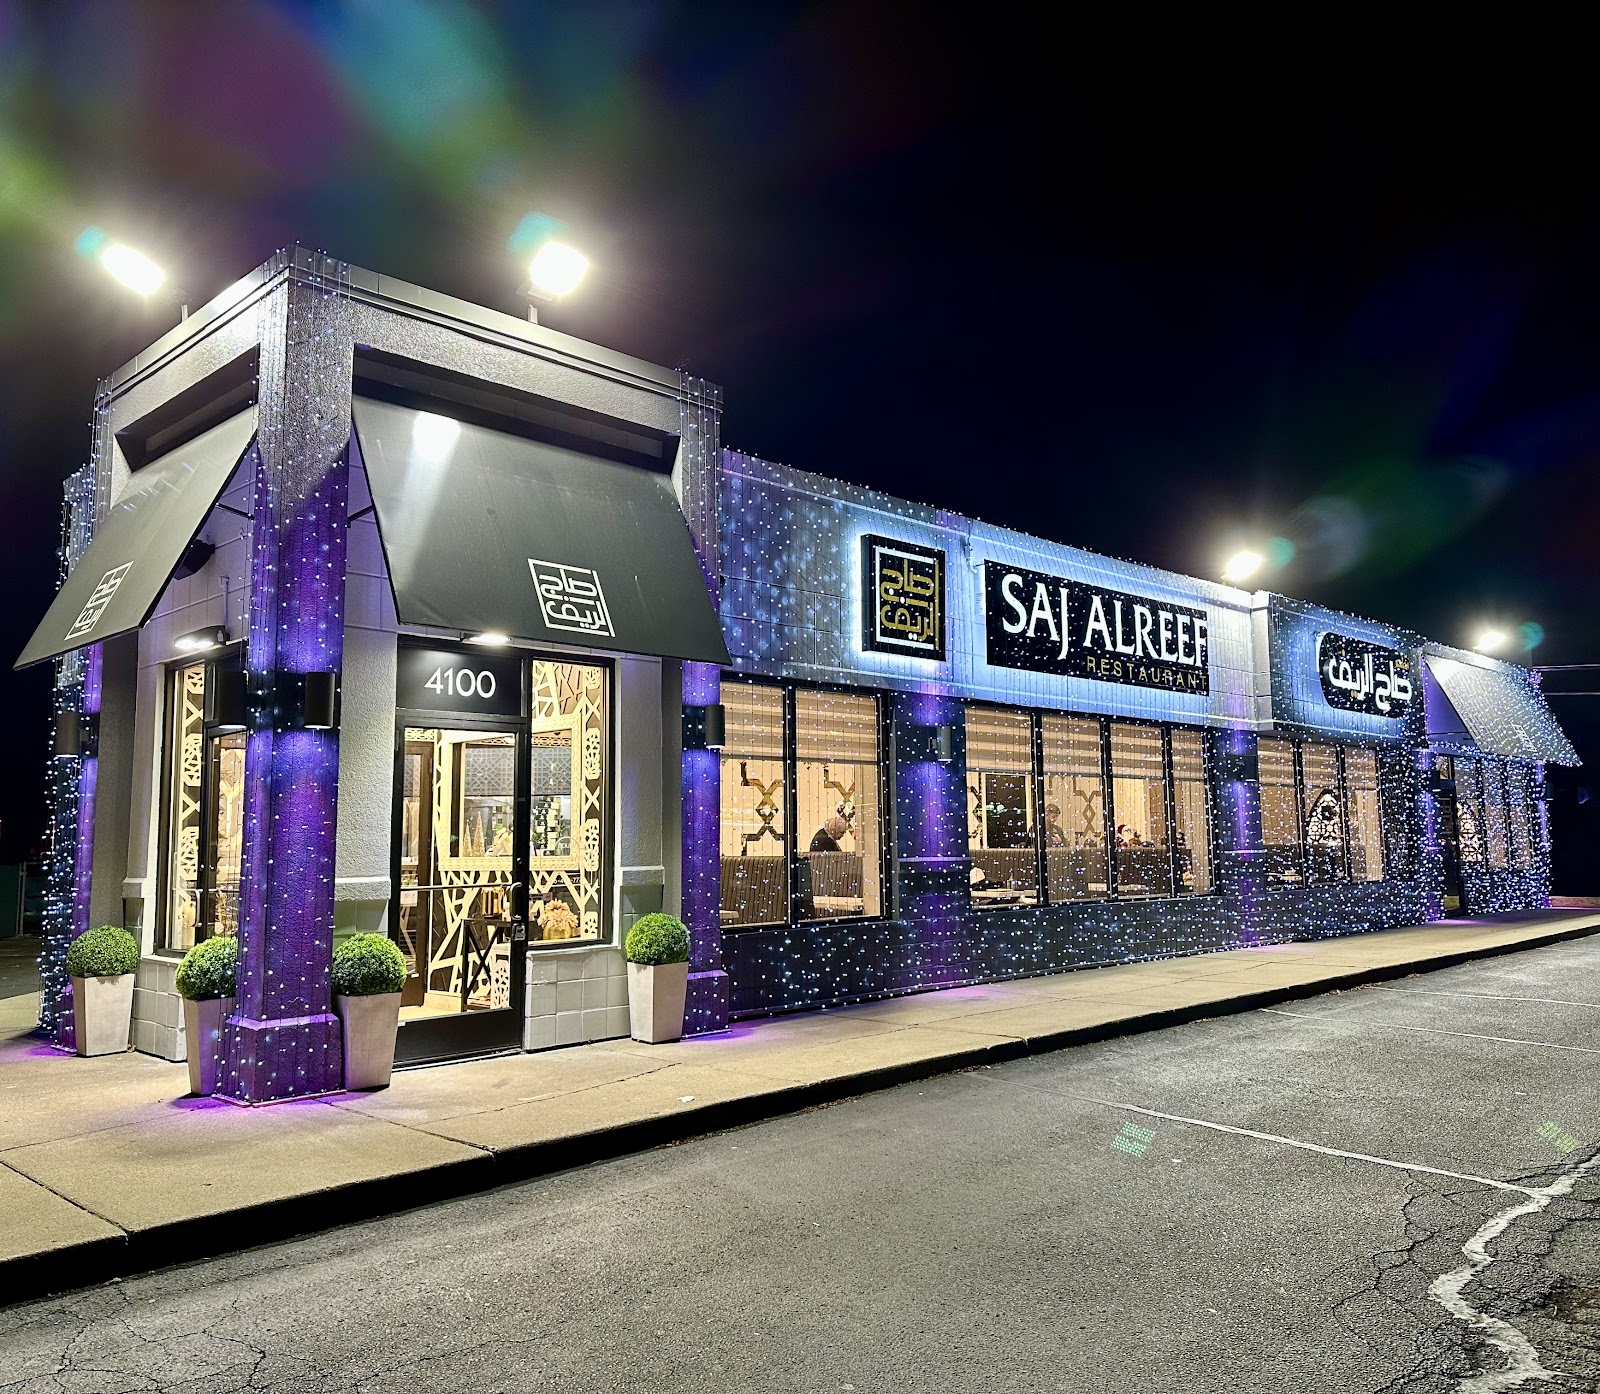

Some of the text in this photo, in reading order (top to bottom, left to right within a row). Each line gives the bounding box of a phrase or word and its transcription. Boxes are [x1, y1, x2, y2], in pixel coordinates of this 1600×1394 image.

[1001, 573, 1207, 667] SAJ ALREEF
[424, 666, 496, 698] 4100
[1086, 655, 1207, 690] RESTAURANT
[1328, 649, 1413, 711] صاج الريف
